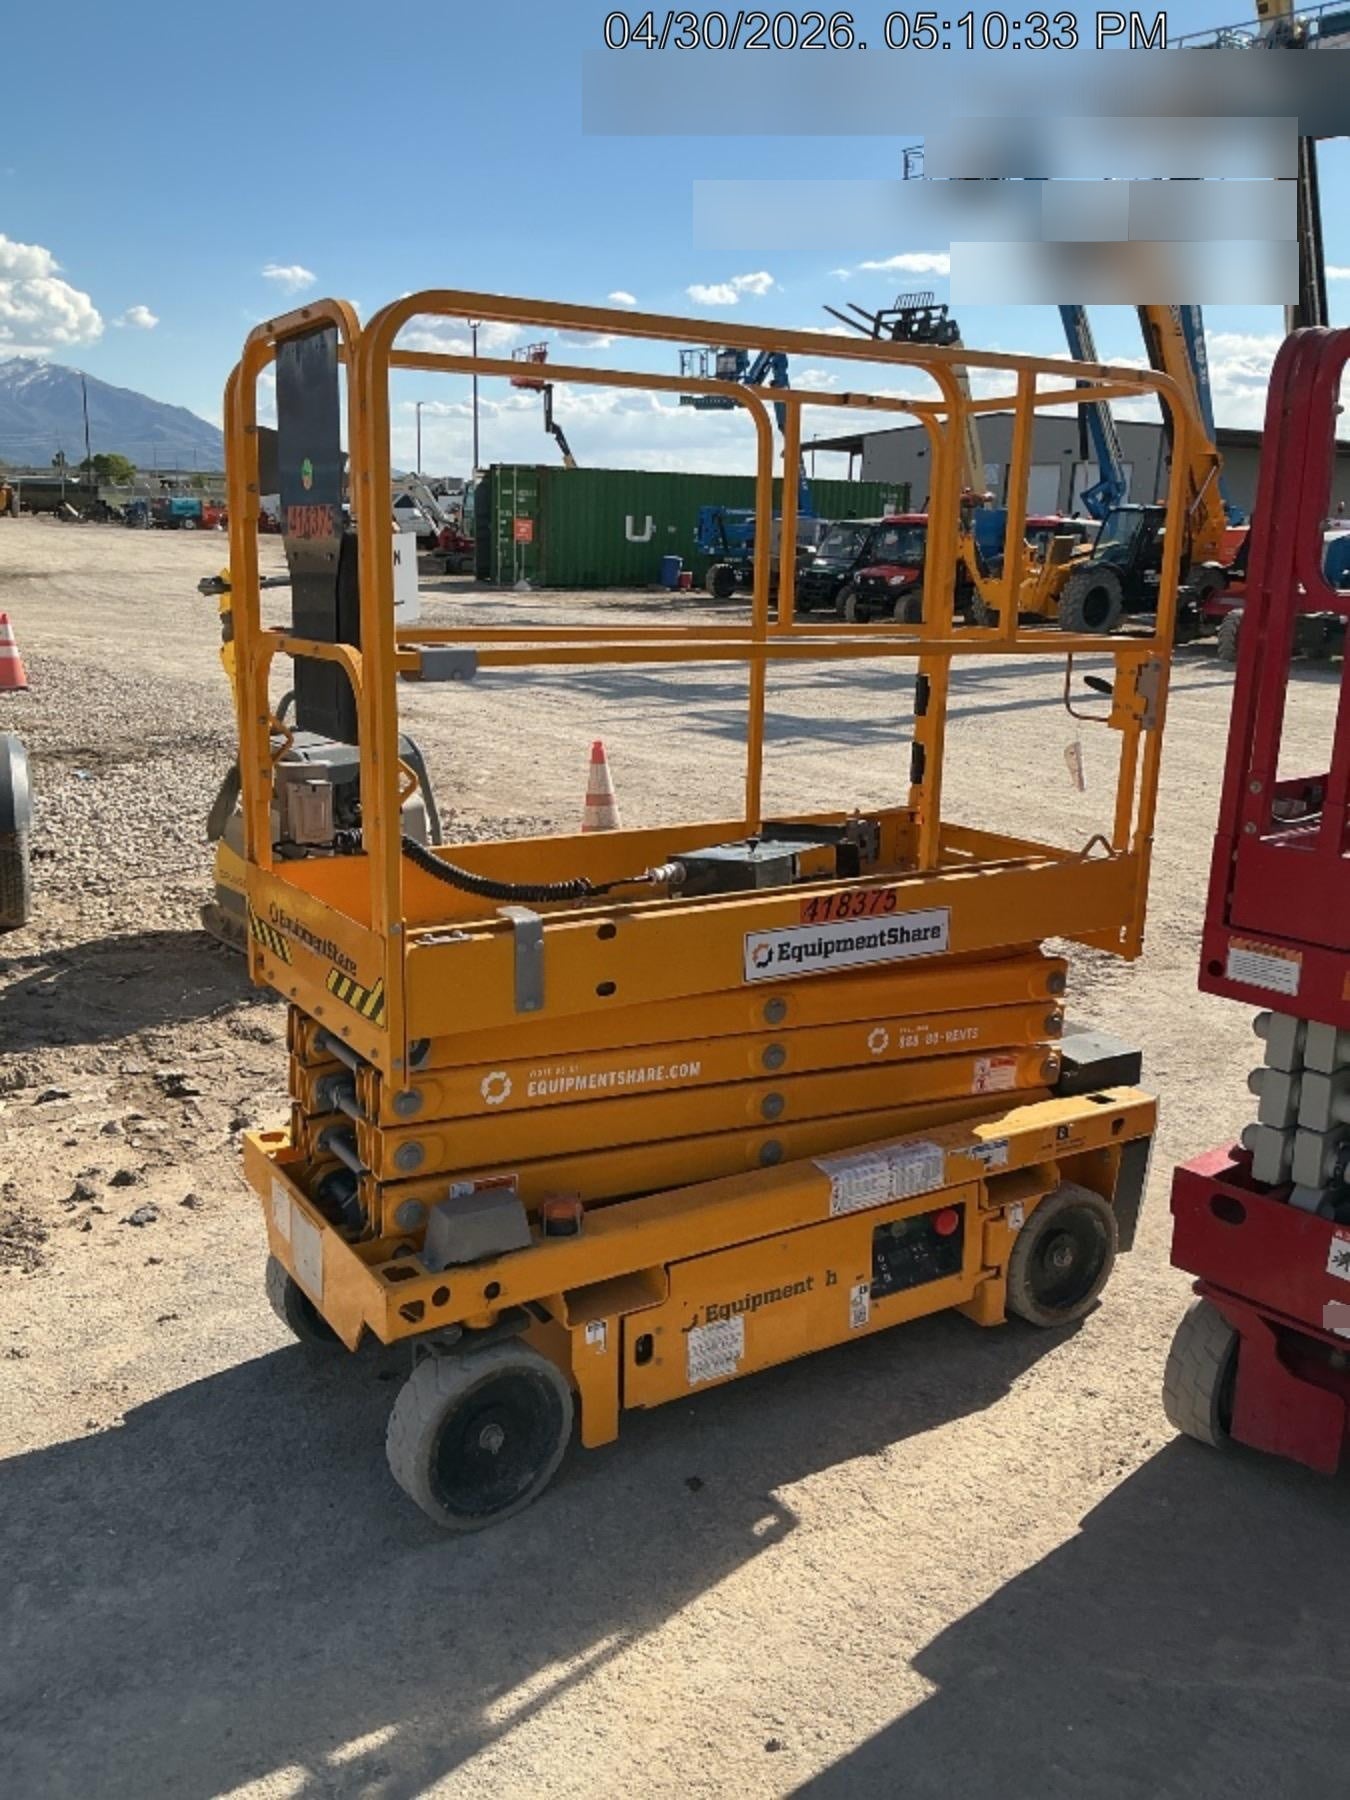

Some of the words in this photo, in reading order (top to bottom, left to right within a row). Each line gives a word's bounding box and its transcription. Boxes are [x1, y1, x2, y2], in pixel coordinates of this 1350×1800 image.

[803, 888, 897, 921] 418375
[777, 925, 941, 962] EquipmentShare
[527, 1062, 701, 1096] EQUIPMENTSHARE.COM
[706, 1275, 814, 1323] Equipment
